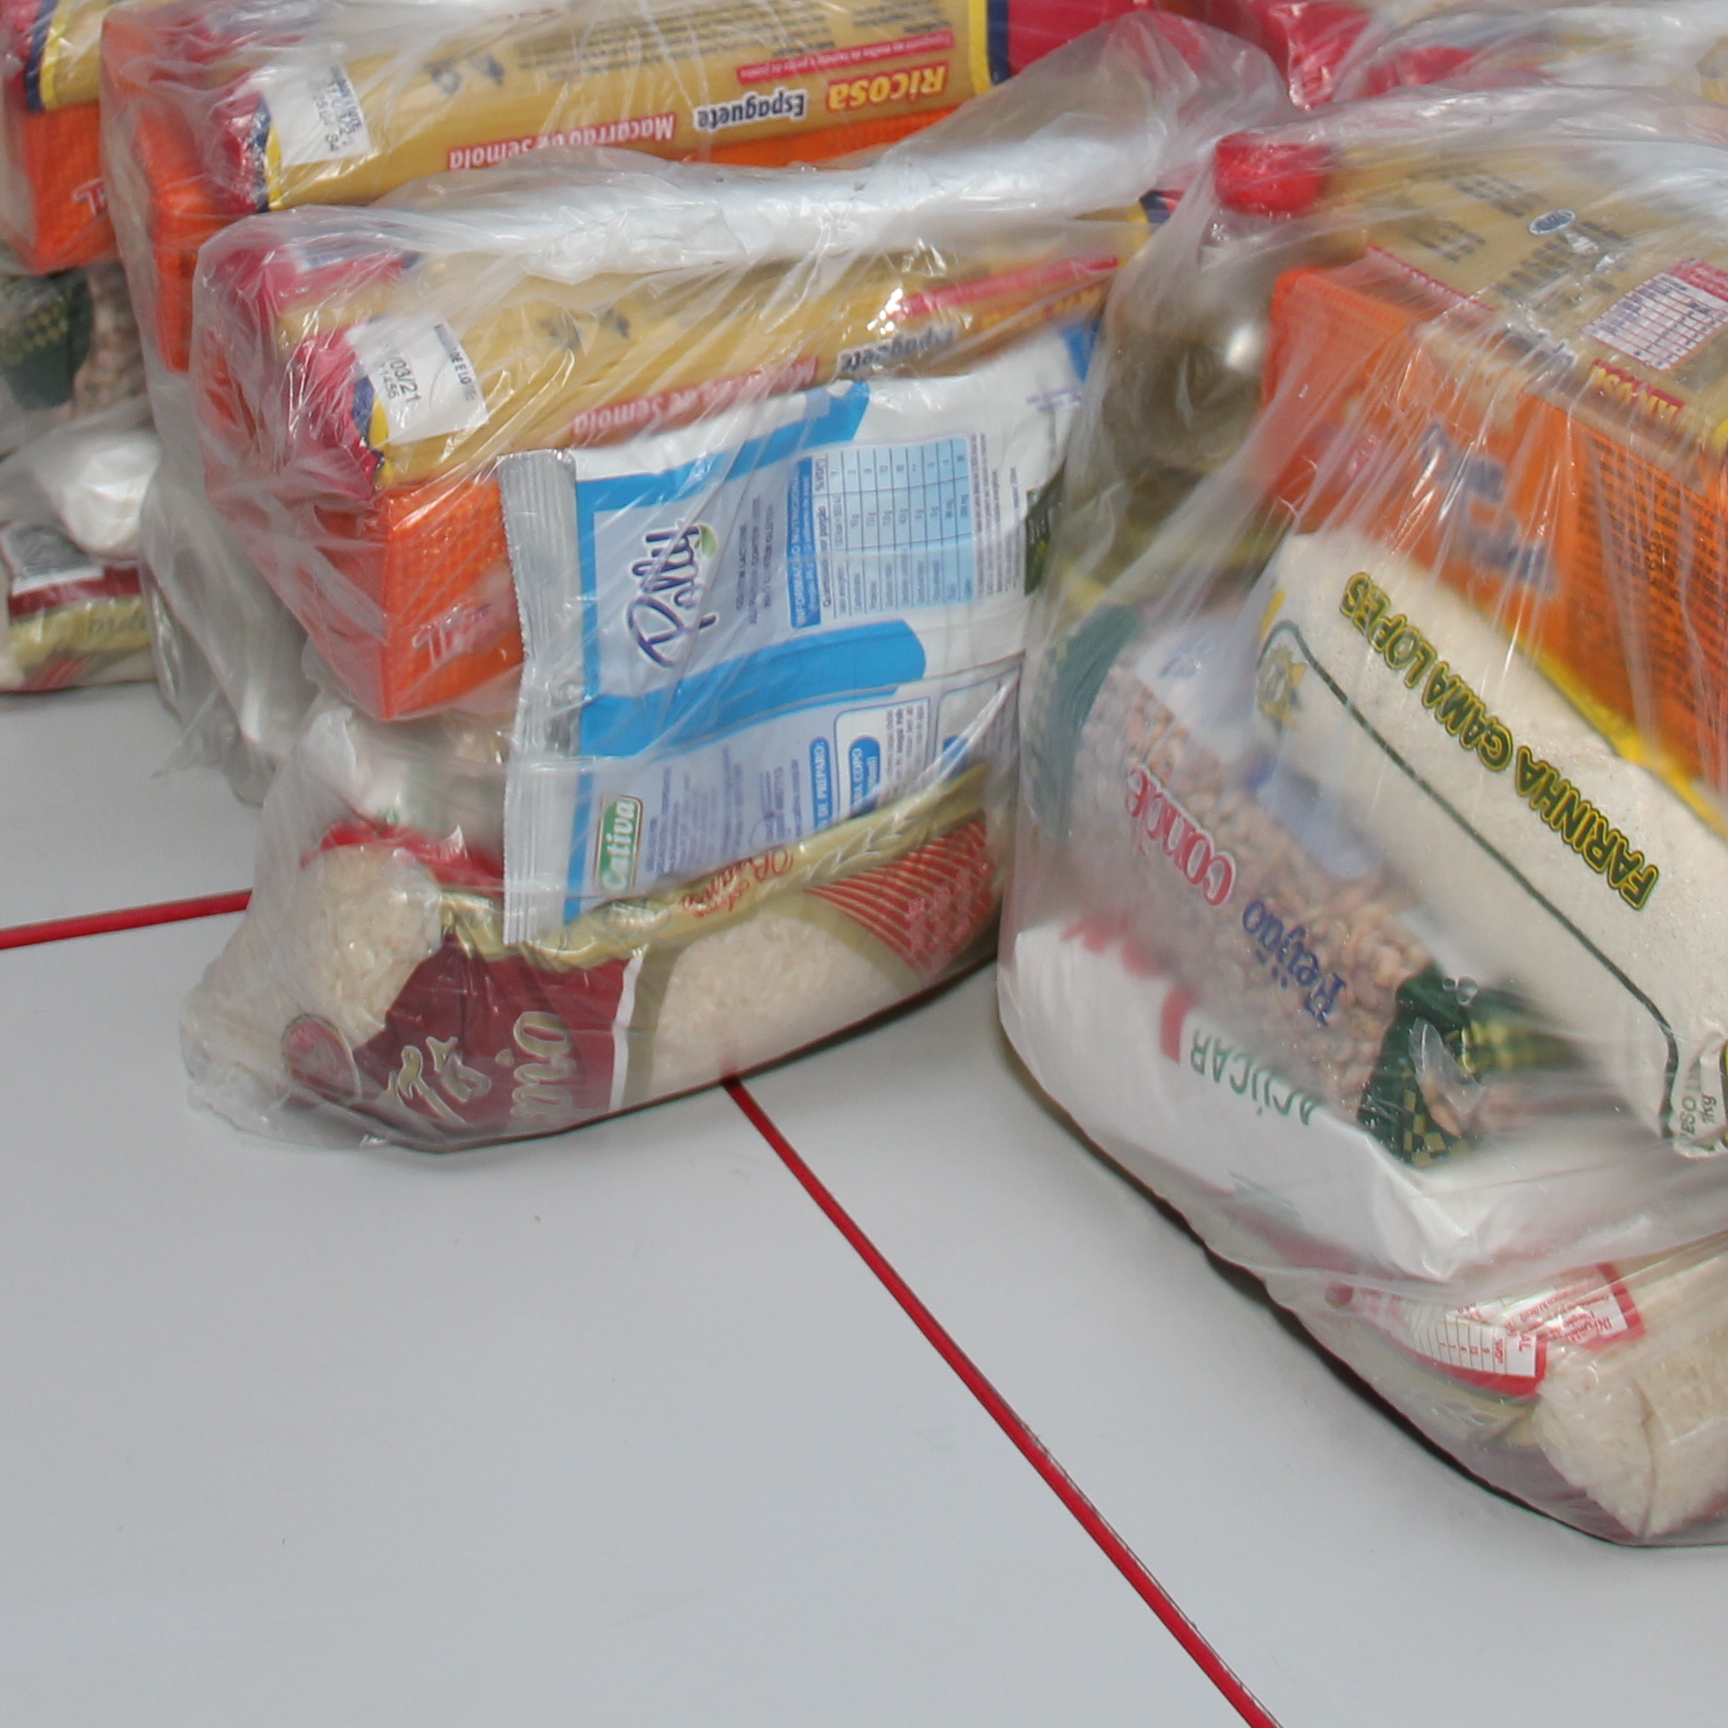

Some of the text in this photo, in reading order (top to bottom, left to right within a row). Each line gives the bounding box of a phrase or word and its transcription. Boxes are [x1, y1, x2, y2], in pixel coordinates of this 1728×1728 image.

[694, 89, 806, 131] Espaguete
[827, 62, 949, 111] Ricosa
[1338, 571, 1660, 910] FARINHA GAMA LOPES
[600, 798, 639, 891] Cativa
[1242, 898, 1348, 1027] Feijão
